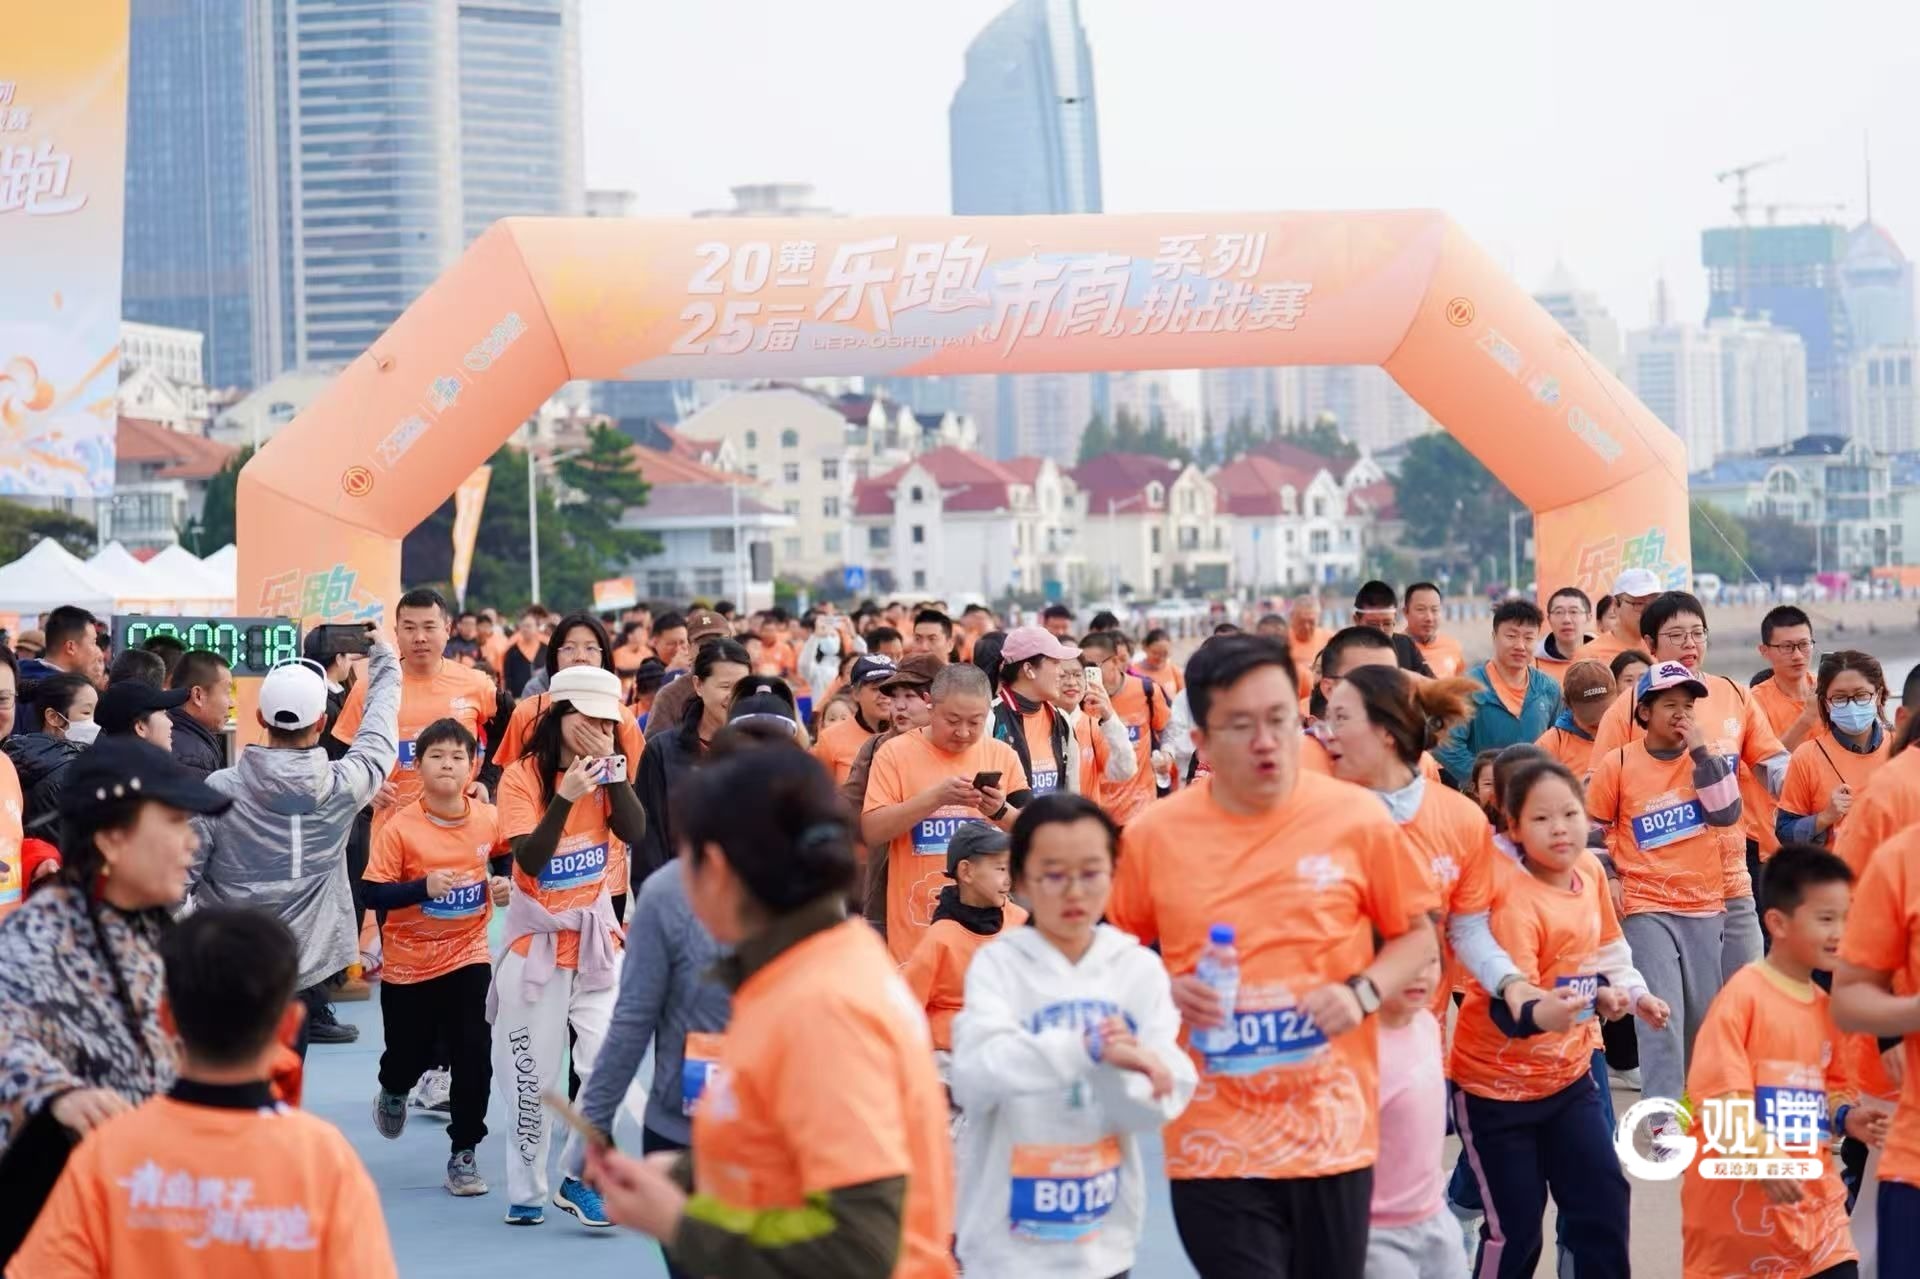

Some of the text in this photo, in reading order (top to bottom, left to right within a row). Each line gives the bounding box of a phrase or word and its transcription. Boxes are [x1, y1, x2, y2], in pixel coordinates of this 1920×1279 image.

[1151, 231, 1270, 281] 系列
[1131, 281, 1313, 335] 挑战赛
[1031, 771, 1058, 788] 0057
[922, 819, 977, 837] B01
[1641, 803, 1696, 833] B0273
[550, 847, 605, 875] B0288
